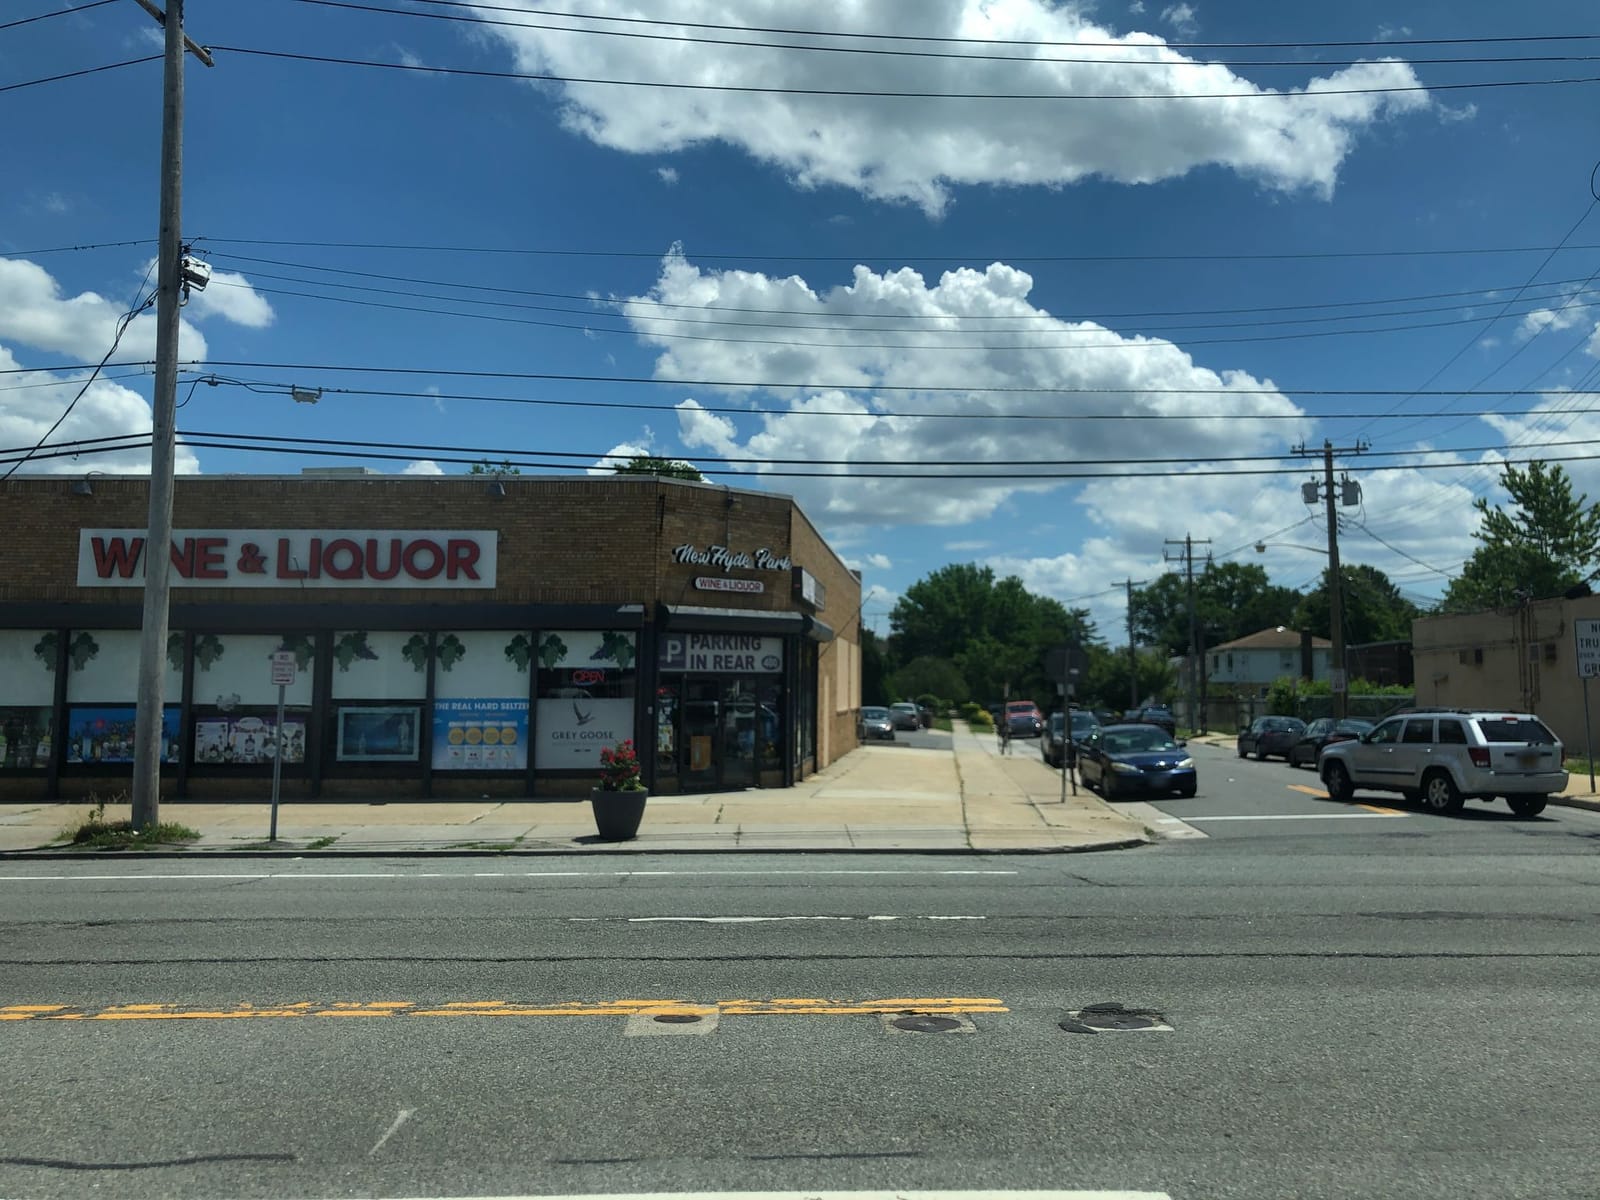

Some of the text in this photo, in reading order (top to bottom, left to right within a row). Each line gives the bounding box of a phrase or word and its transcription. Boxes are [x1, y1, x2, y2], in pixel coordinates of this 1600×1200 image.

[91, 538, 481, 580] WNE & LIQUOR
[673, 544, 792, 572] New Hyde Park
[699, 577, 721, 589] WINE
[729, 579, 761, 591] LIQUOR
[1591, 623, 1600, 633] N
[690, 634, 762, 651] PARKING
[690, 655, 755, 670] IN REAR
[573, 668, 605, 684] OPEN
[434, 702, 450, 710] THE
[451, 702, 472, 710] REAL
[474, 702, 499, 710] HARD
[551, 731, 614, 740] GREY GOOSE
